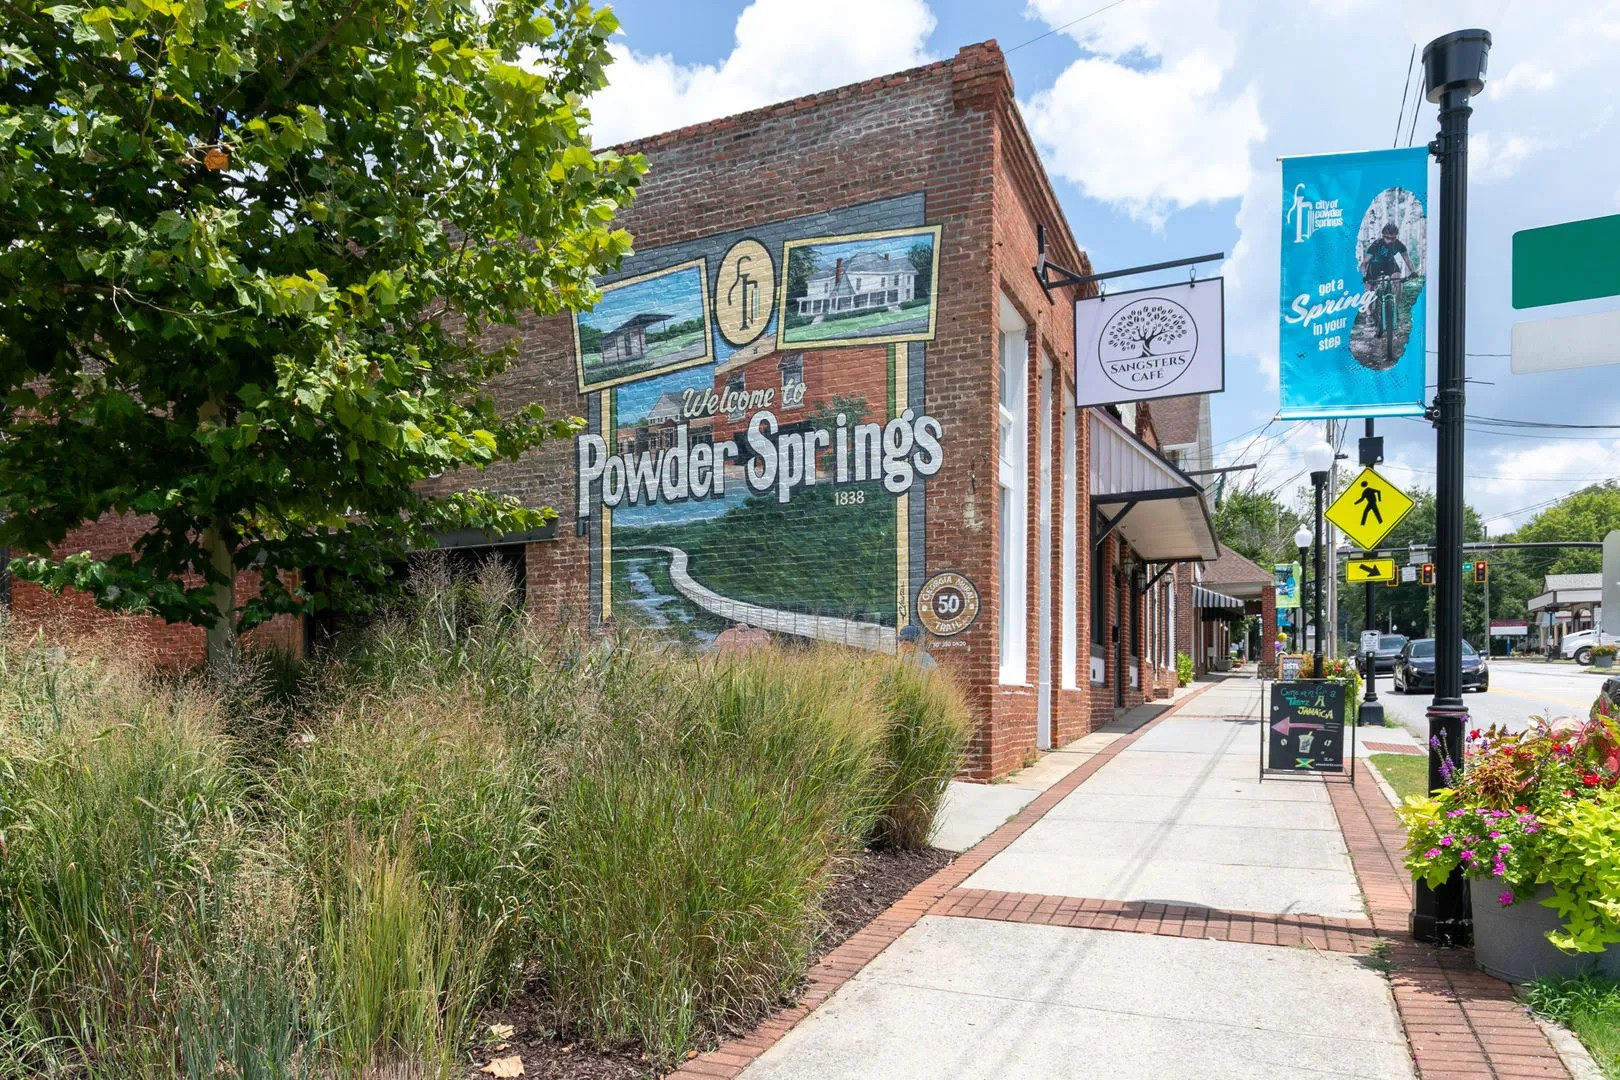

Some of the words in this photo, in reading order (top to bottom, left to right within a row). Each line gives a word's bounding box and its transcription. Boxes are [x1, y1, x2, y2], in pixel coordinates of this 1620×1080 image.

[1315, 200, 1330, 210] city
[1330, 199, 1339, 208] of
[1314, 209, 1343, 219] powder
[1314, 218, 1343, 228] springs
[1319, 281, 1336, 296] get
[1337, 279, 1344, 290] a
[1285, 290, 1377, 327] Spring
[1313, 322, 1323, 336] in
[1324, 317, 1347, 335] your
[1319, 335, 1341, 351] step
[1110, 355, 1186, 374] SANGSTERS
[682, 386, 775, 419] Welcome
[781, 378, 807, 404] to
[578, 424, 738, 517] Powder
[747, 408, 943, 503] Springs
[834, 491, 865, 506] 1838
[922, 576, 952, 600] GEORGIA
[955, 579, 975, 602] MURAL
[938, 595, 960, 613] 50
[935, 621, 962, 632] TRAIL
